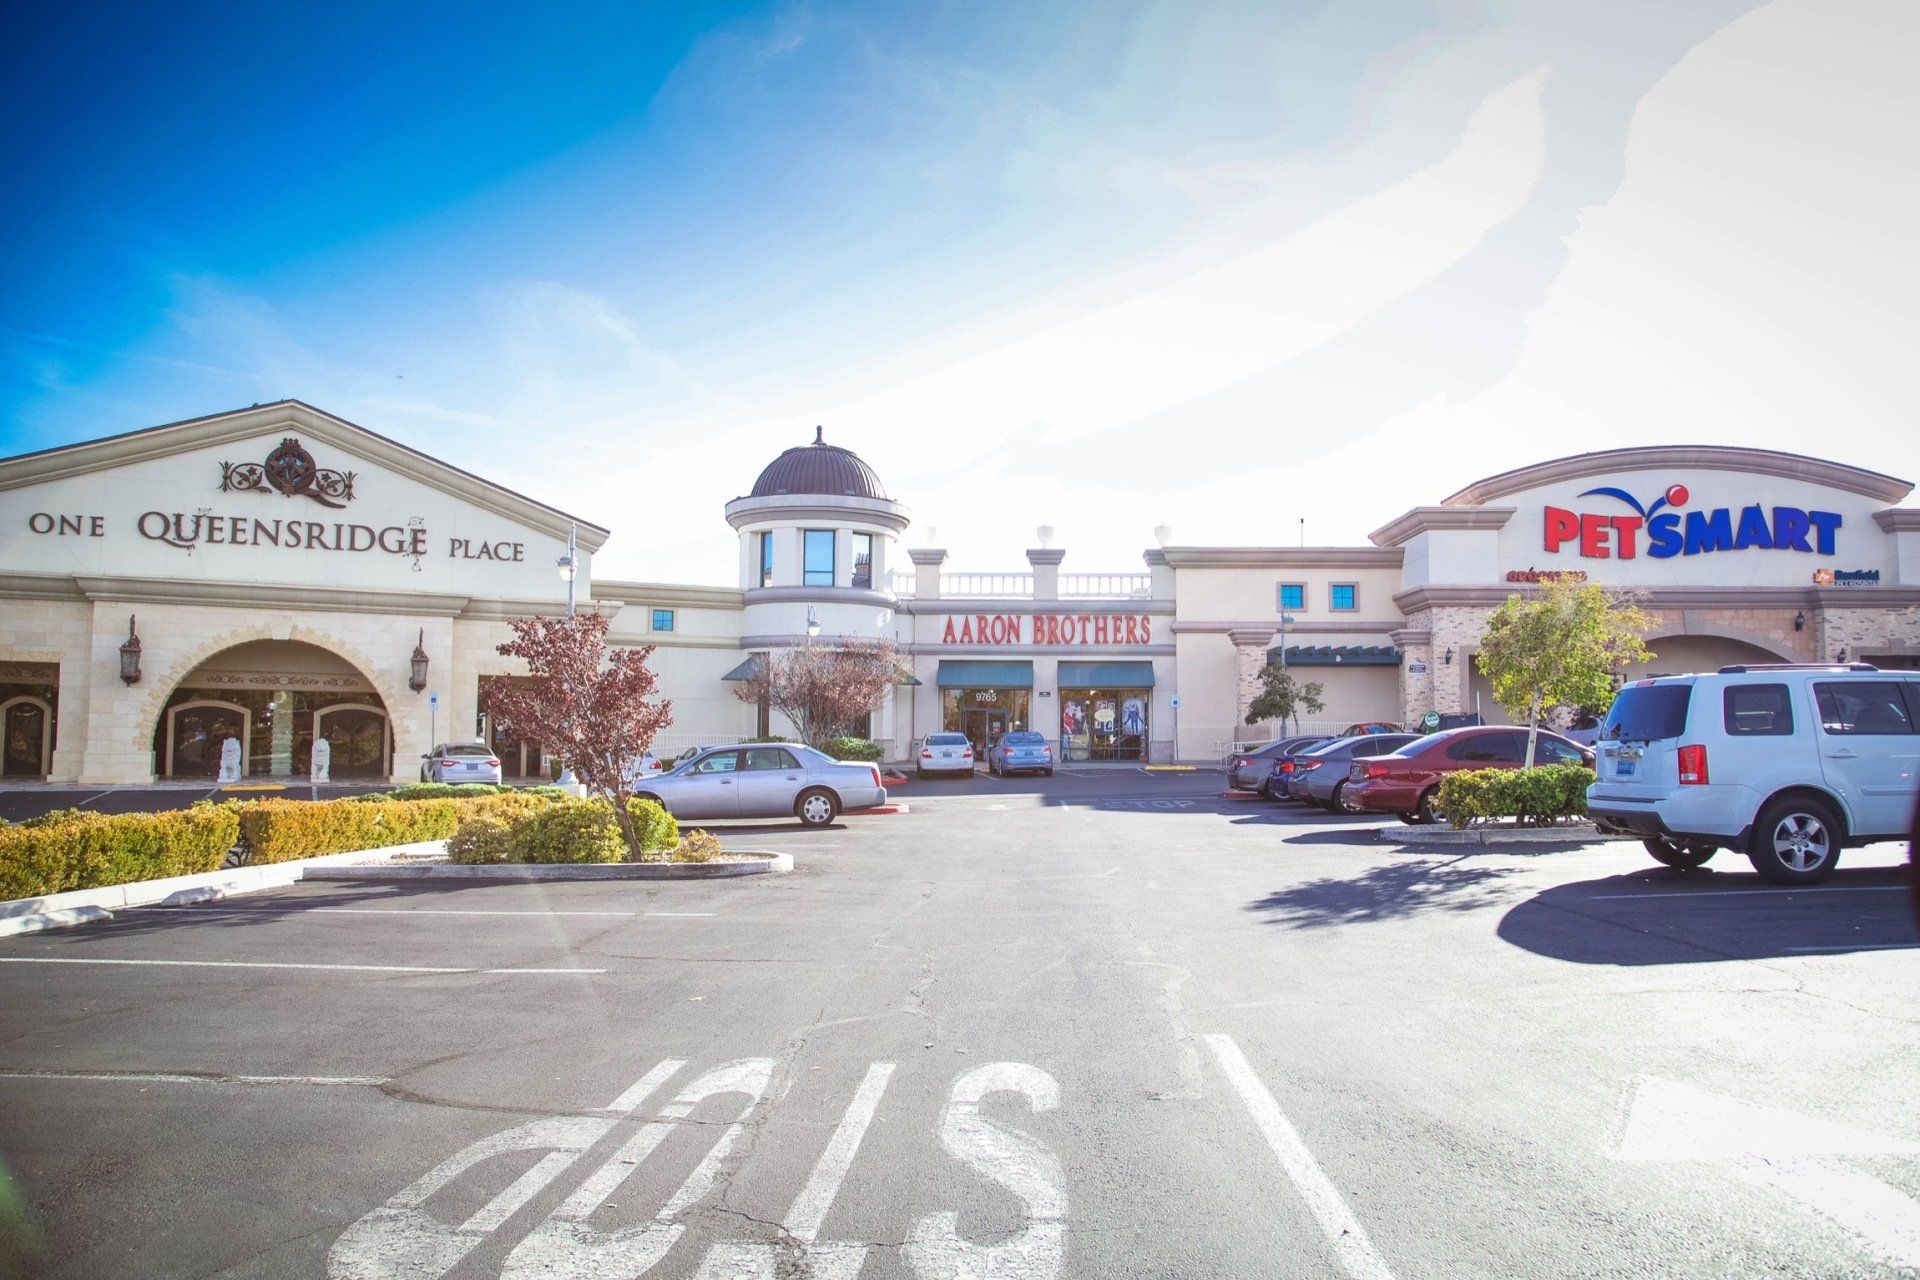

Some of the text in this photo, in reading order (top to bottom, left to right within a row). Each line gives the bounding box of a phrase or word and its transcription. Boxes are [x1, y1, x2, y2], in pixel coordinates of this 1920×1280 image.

[29, 511, 524, 562] ONE QUEENSRIDGE PLACE
[1544, 503, 1842, 559] PETSMART
[943, 614, 1152, 645] AARON BROTHERS
[975, 692, 997, 702] 9765
